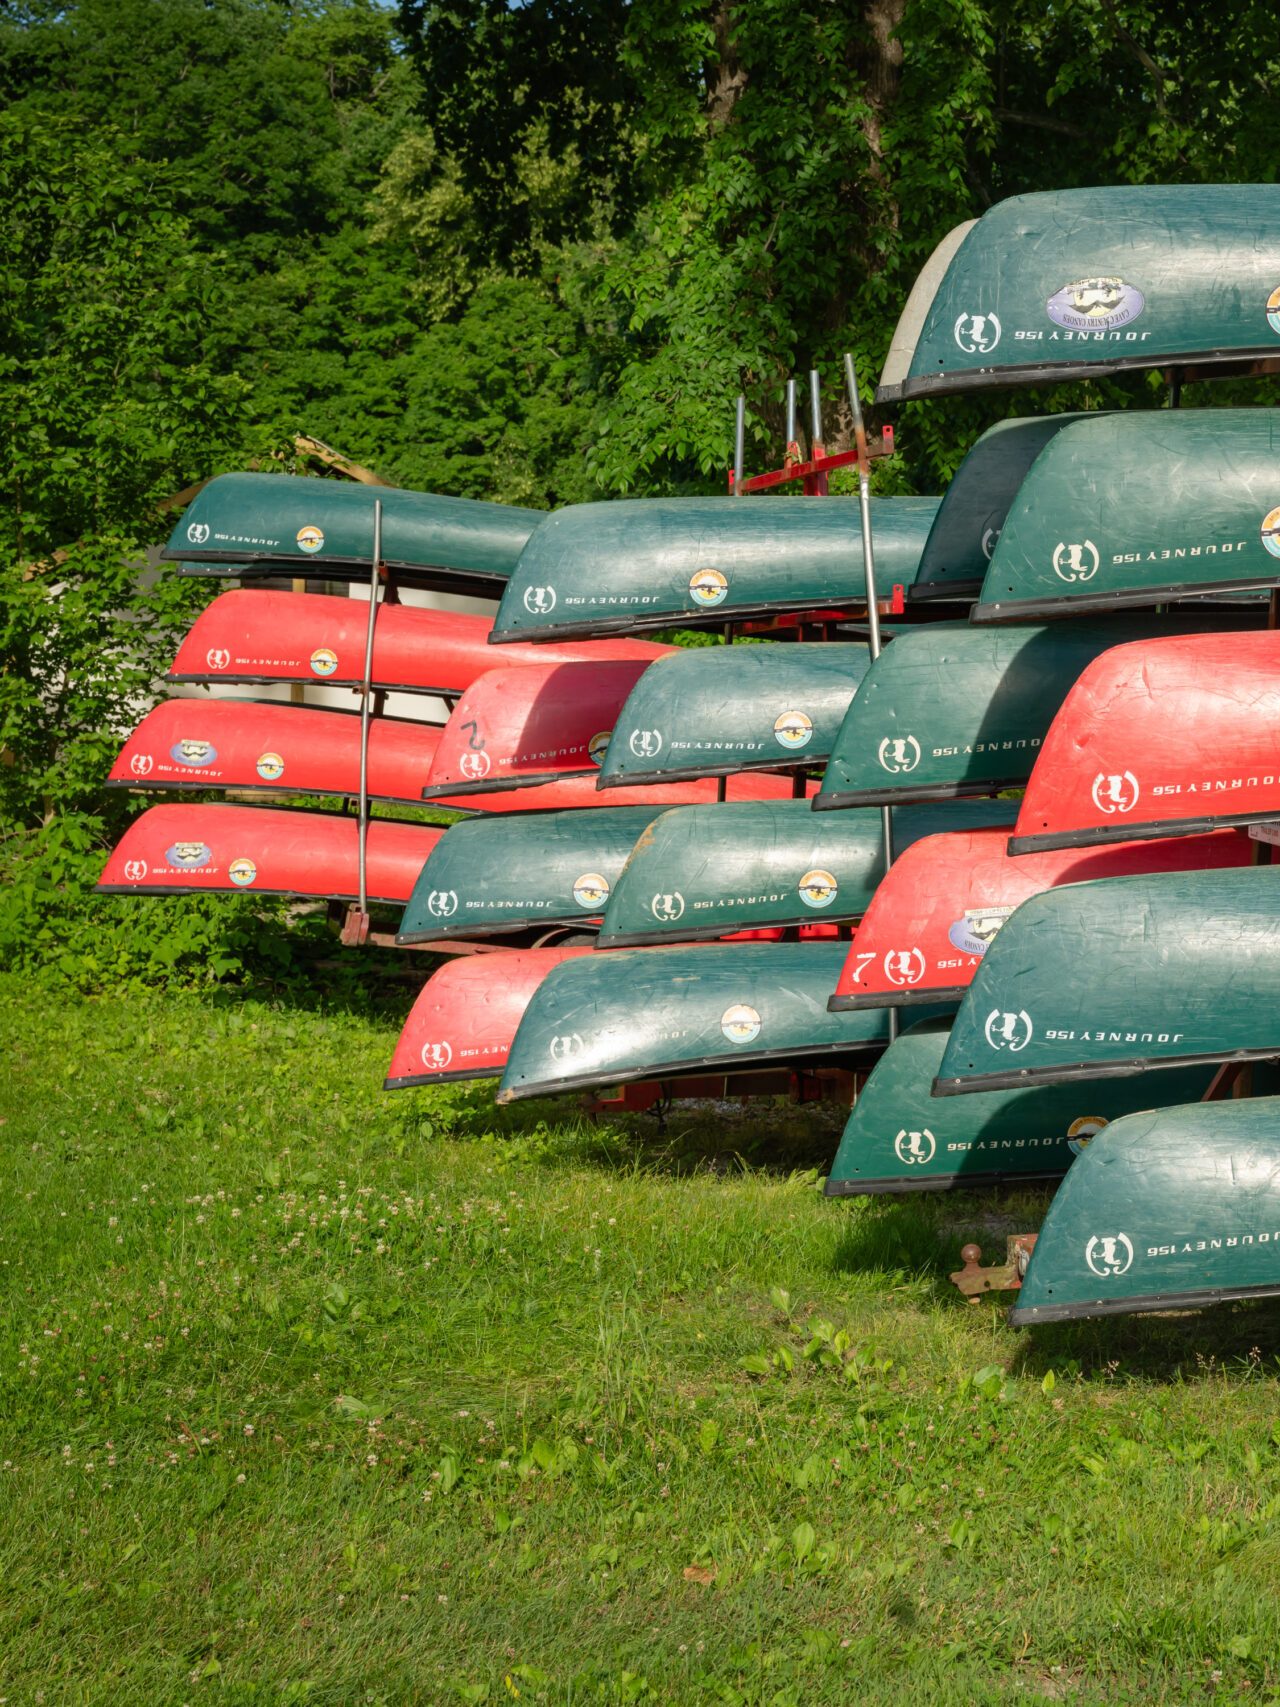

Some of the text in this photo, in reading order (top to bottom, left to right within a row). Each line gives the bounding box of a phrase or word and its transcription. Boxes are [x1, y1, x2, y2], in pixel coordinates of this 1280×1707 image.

[1014, 331, 1152, 341] JOURNEY 156
[230, 535, 281, 546] JOURNEY
[1147, 541, 1248, 561] JOURNEY
[1113, 553, 1141, 564] 156
[588, 596, 660, 604] JOURNEY
[671, 741, 765, 750] JOURNEY 156
[932, 738, 1041, 757] OURNEY 156
[1152, 785, 1182, 795] 156
[693, 893, 788, 909] JOURNEY 156
[852, 952, 877, 983] 7
[937, 958, 963, 969] 156
[1045, 1030, 1184, 1042] JOURNEY 156
[459, 1049, 479, 1057] 156
[947, 1137, 1065, 1151] JOURNEY 156
[1147, 1245, 1177, 1257] 156
